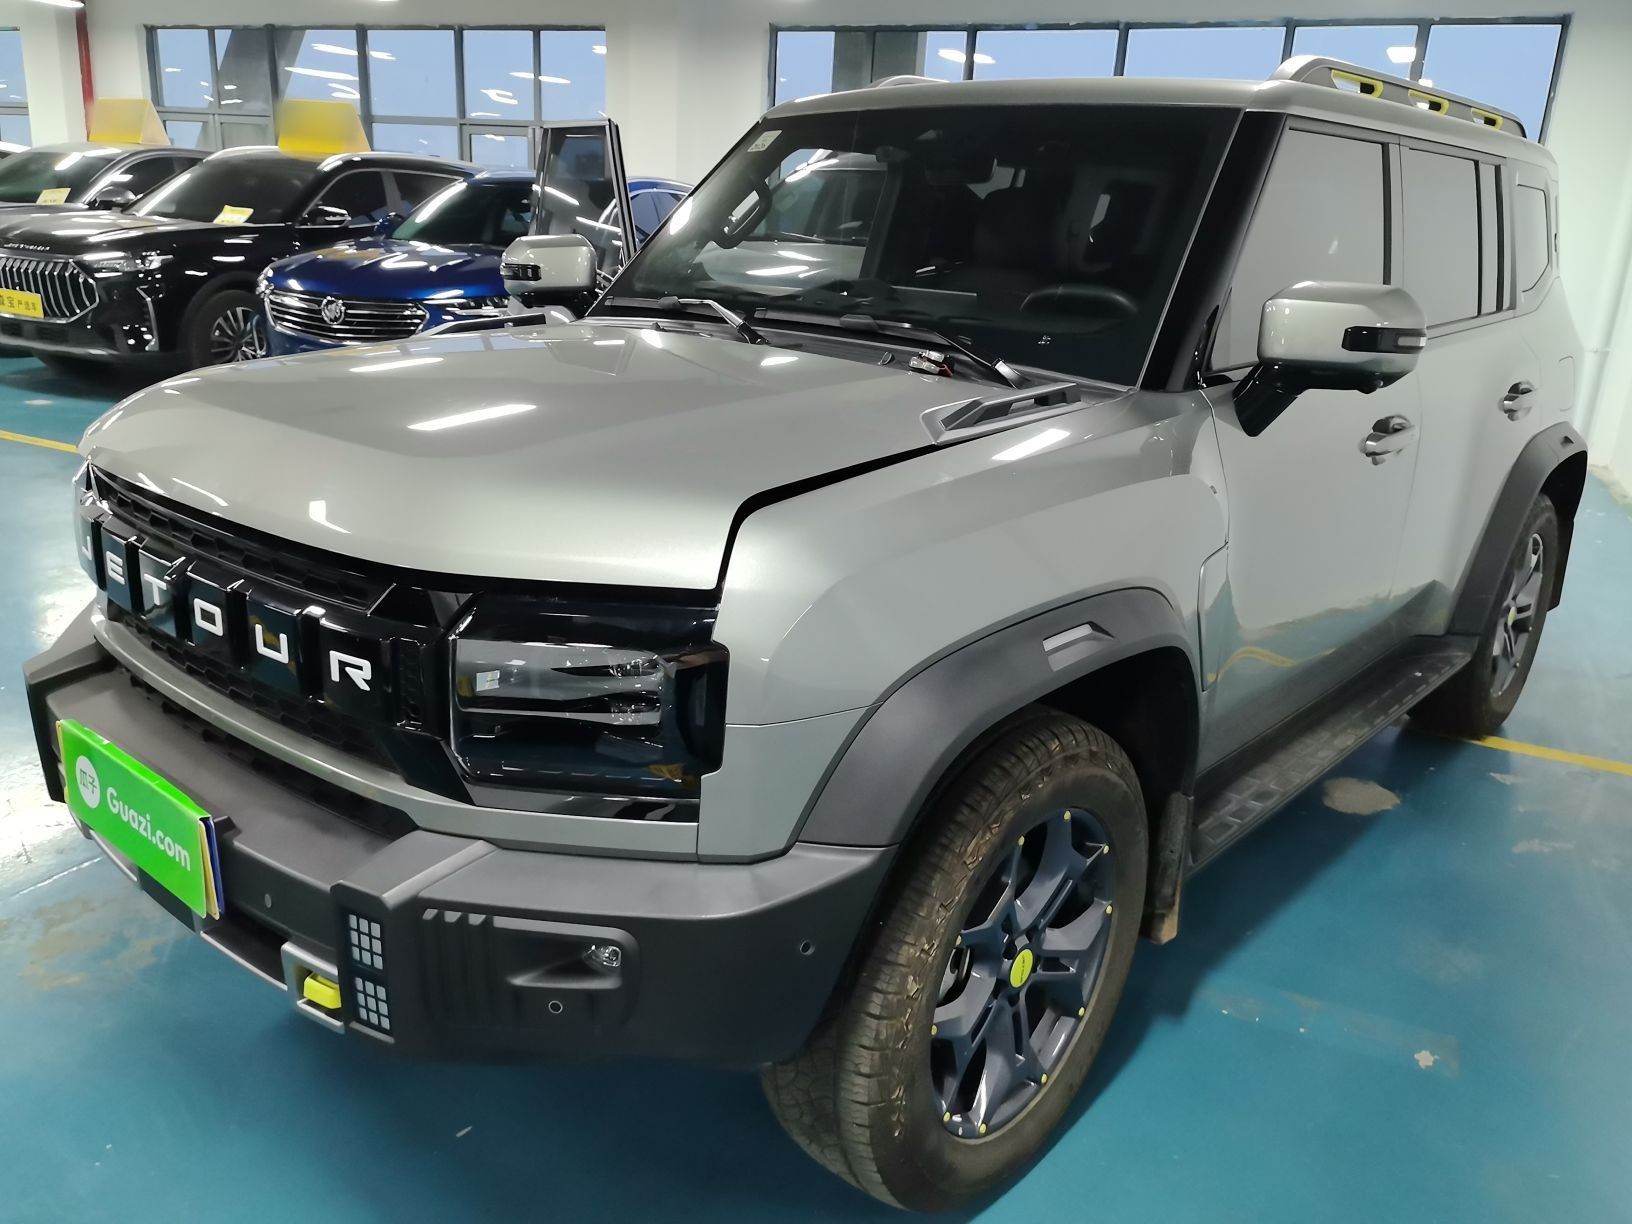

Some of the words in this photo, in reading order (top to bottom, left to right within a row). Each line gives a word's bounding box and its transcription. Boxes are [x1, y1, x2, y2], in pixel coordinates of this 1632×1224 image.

[81, 535, 372, 692] JETOUR
[79, 767, 98, 795] 瓜子
[106, 786, 192, 872] Guazi.com
